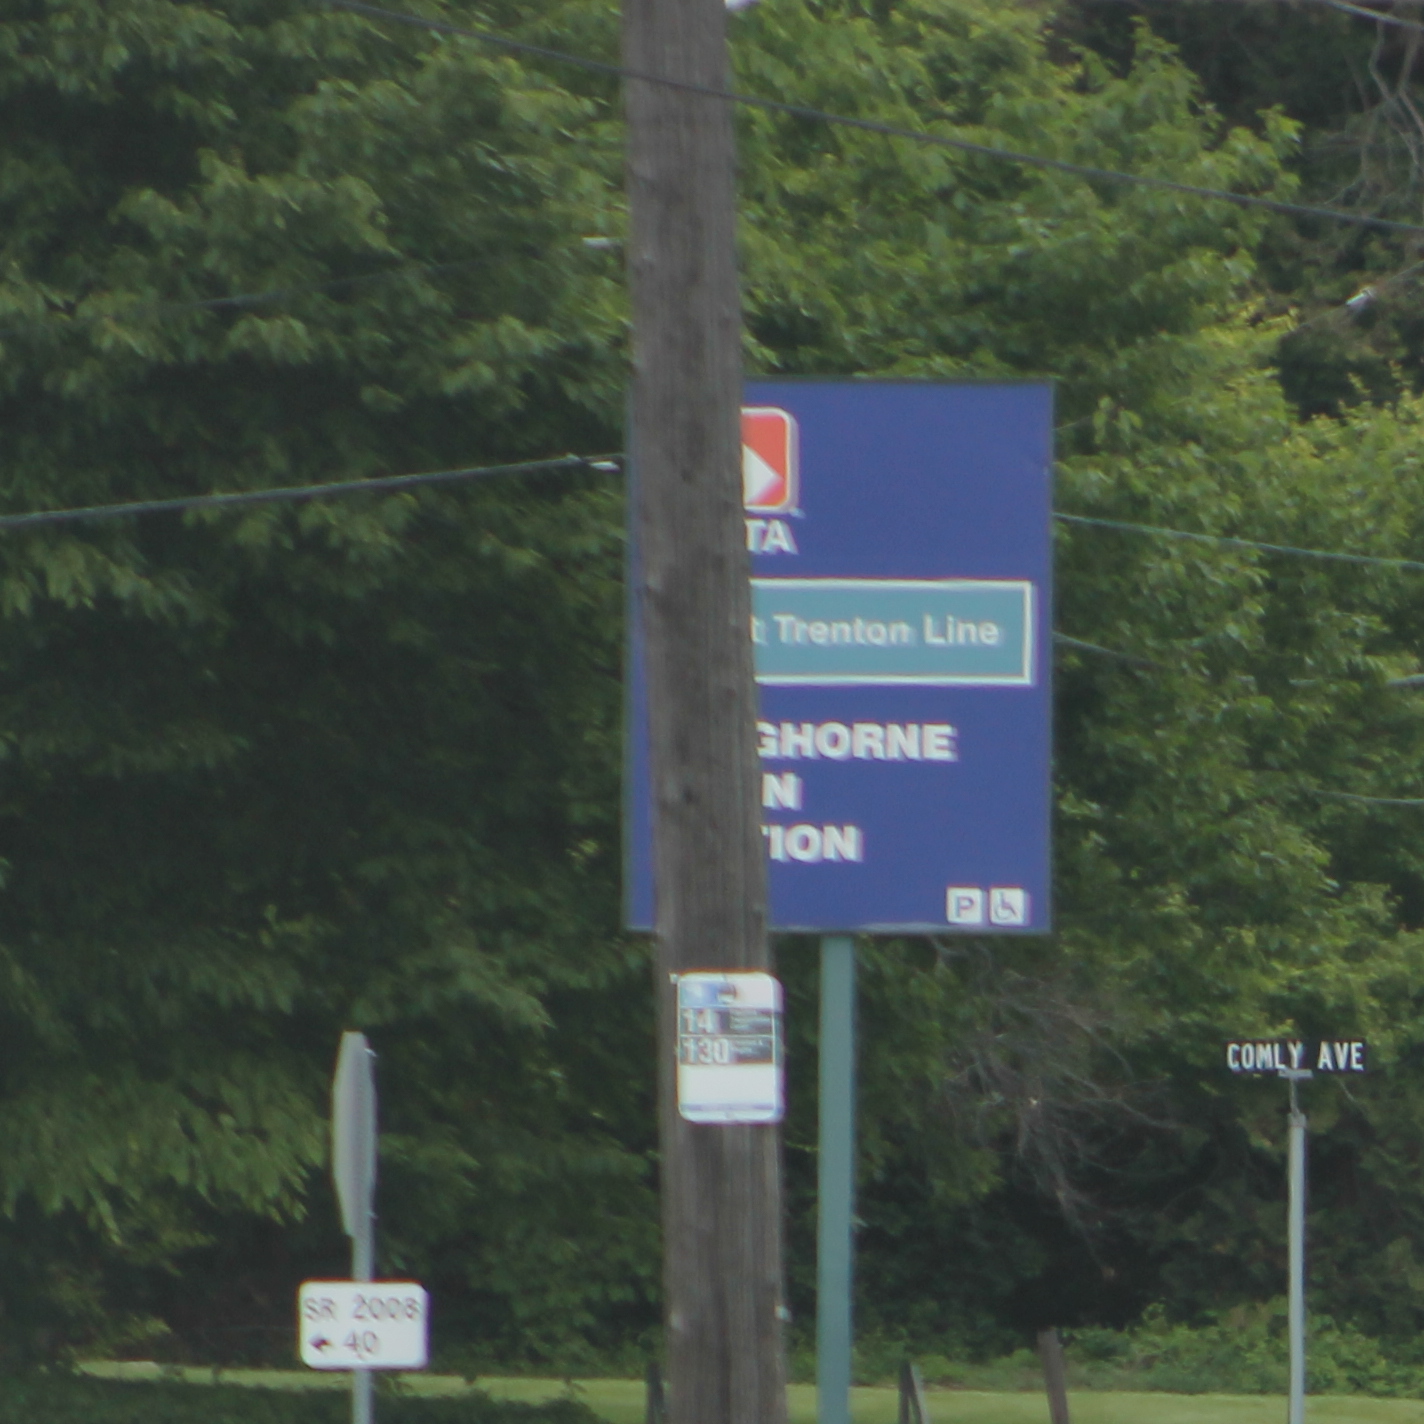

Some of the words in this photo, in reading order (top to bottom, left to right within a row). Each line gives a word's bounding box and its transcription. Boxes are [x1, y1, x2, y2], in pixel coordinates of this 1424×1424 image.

[773, 612, 915, 646] Trenton
[922, 612, 1000, 646] Line
[682, 1008, 718, 1034] 14
[682, 1037, 729, 1064] 130
[1227, 1041, 1302, 1071] COMLY
[1317, 1040, 1364, 1071] AVE
[304, 1297, 334, 1321] SR
[353, 1294, 420, 1320] 2008
[343, 1330, 377, 1353] 40
